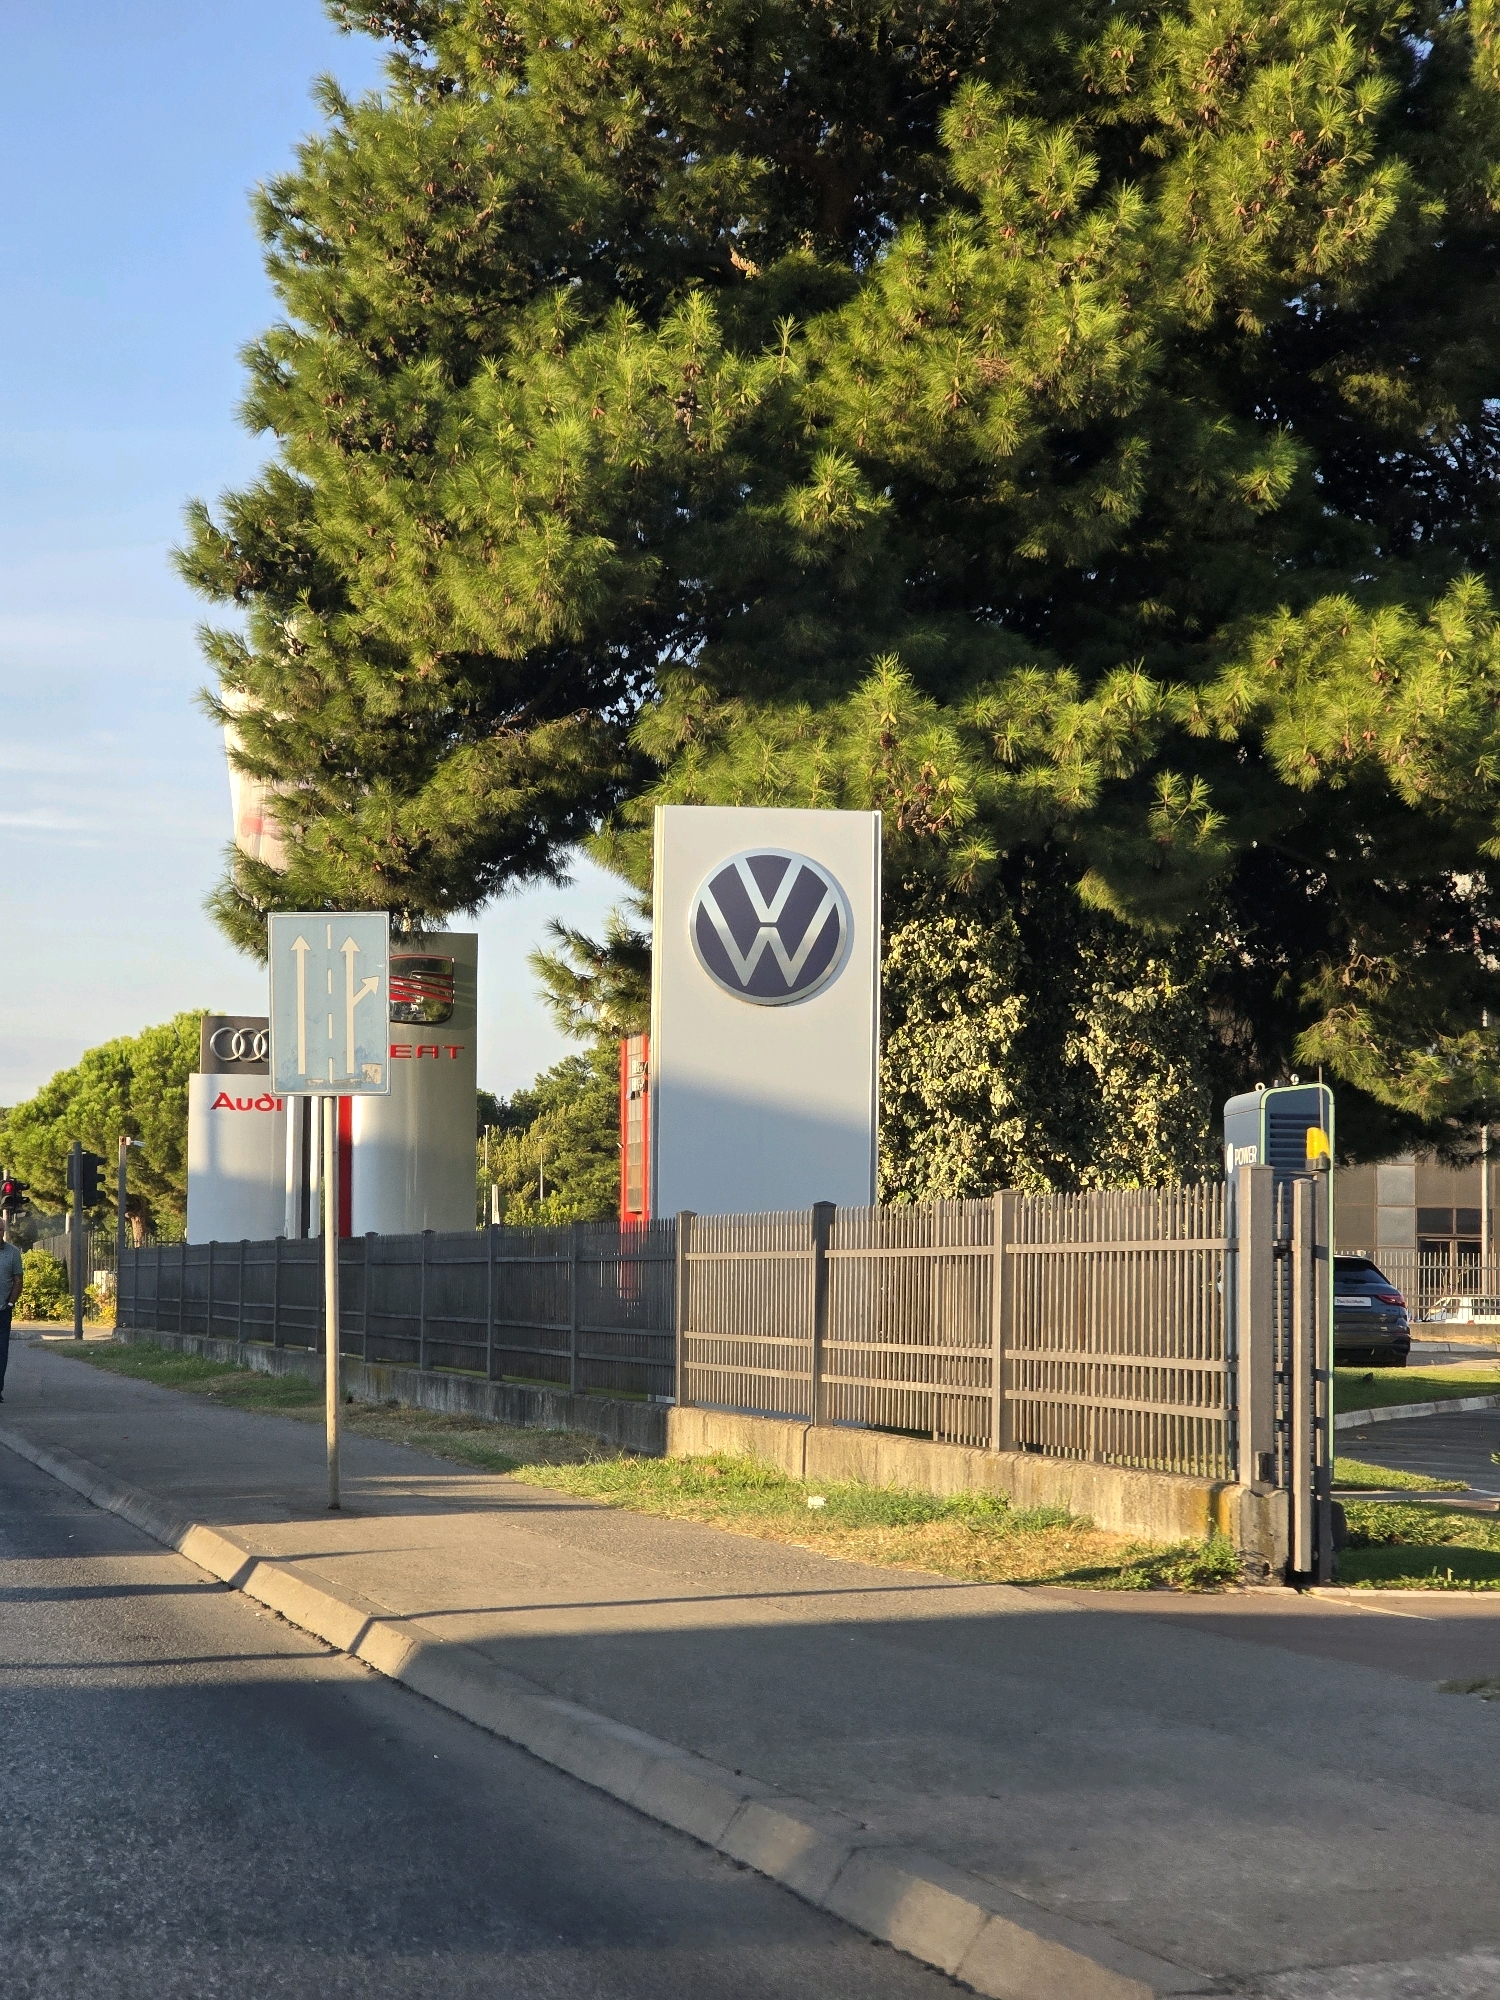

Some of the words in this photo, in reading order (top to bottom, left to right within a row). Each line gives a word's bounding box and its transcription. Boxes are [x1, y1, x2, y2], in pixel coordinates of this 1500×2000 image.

[700, 853, 839, 988] VW
[390, 1044, 465, 1059] EAT
[210, 1092, 282, 1112] Audi
[1234, 1145, 1257, 1165] POWER
